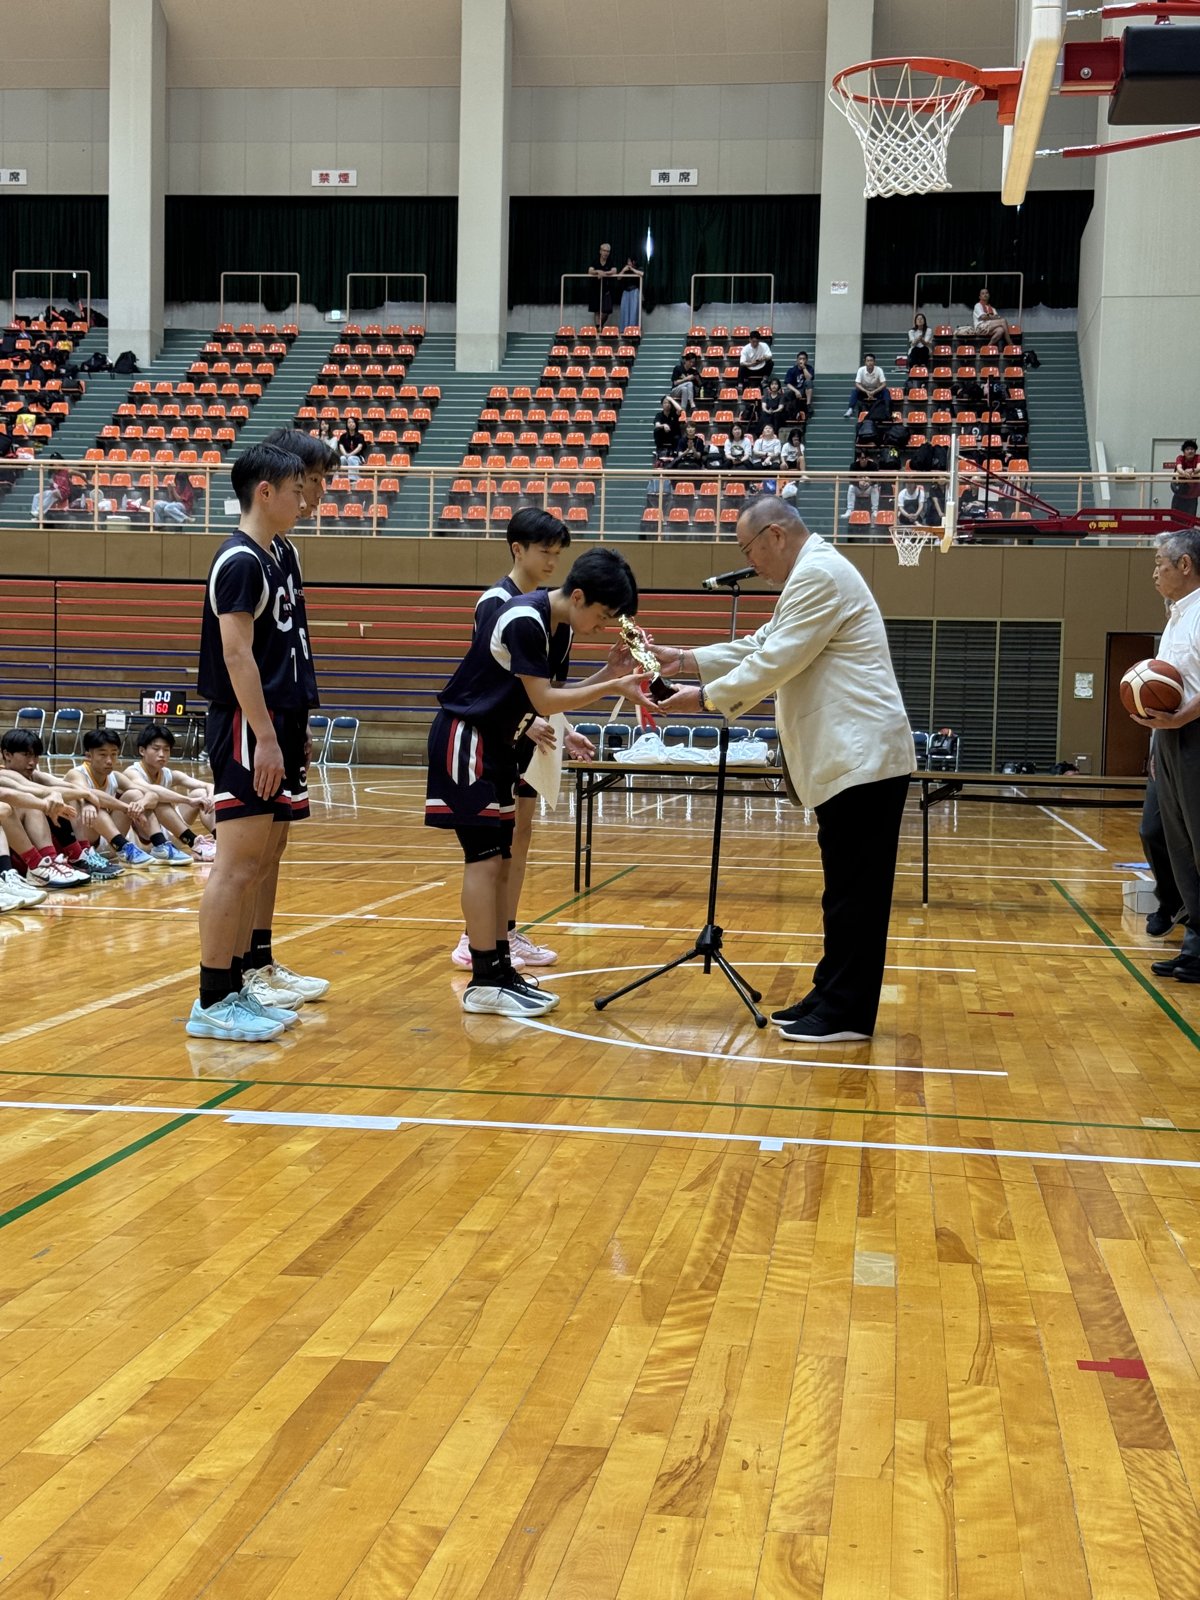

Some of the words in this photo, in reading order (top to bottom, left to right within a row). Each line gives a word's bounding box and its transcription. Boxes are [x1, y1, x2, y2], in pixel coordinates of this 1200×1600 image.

[0, 171, 20, 182] 席
[318, 172, 350, 184] 禁煙
[658, 171, 691, 183] 南席
[298, 627, 309, 660] 6
[154, 690, 171, 702] 0.0
[156, 703, 169, 714] 60
[176, 704, 183, 715] 0
[513, 713, 534, 741] 5
